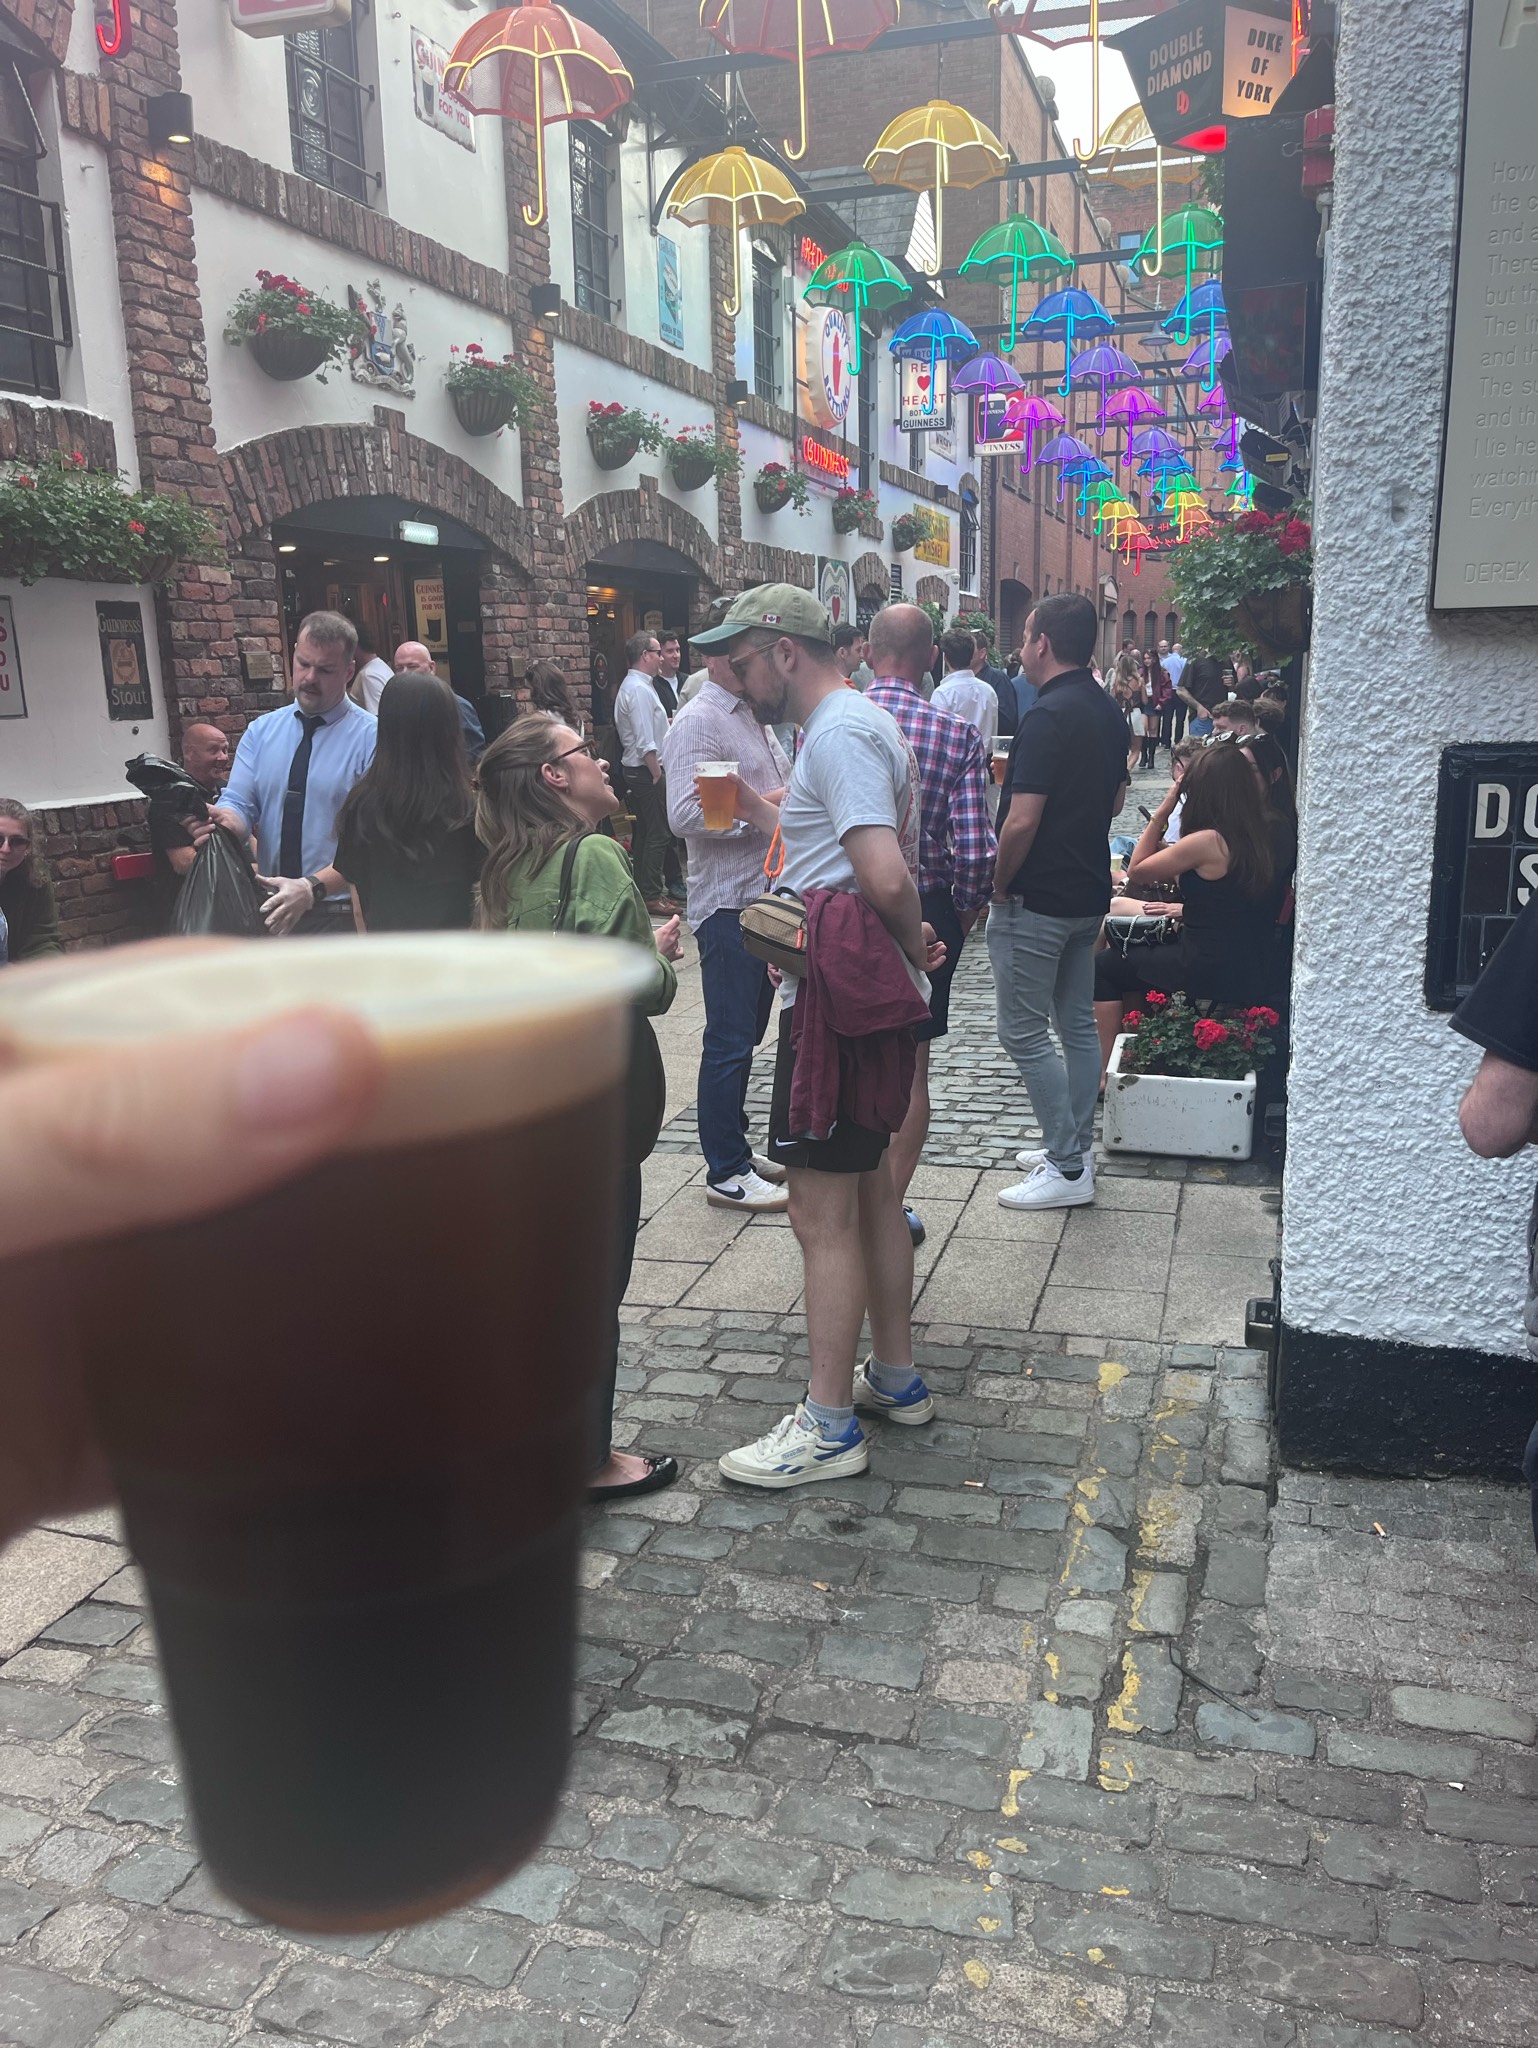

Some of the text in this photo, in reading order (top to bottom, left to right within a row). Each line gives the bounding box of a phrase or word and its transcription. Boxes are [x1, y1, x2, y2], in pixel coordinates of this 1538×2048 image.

[1150, 26, 1204, 70] DOUBLE
[1247, 28, 1283, 53] DUKE
[1147, 50, 1212, 96] DIAMOND
[1251, 56, 1270, 76] OF
[1237, 79, 1273, 104] YORK
[438, 98, 471, 129] FOR YOU
[1492, 161, 1536, 183] How
[1491, 193, 1521, 215] the
[1488, 222, 1524, 244] and
[1485, 286, 1516, 307] but
[825, 312, 851, 348] QUALITY
[1484, 315, 1518, 337] The
[1481, 345, 1517, 367] and
[824, 374, 851, 418] BOTTLING
[1480, 376, 1513, 398] The
[903, 417, 945, 428] GUINNESS
[1476, 406, 1512, 428] and
[803, 435, 850, 478] GUINNESS
[1486, 437, 1506, 458] lie
[1464, 561, 1530, 584] DEREK
